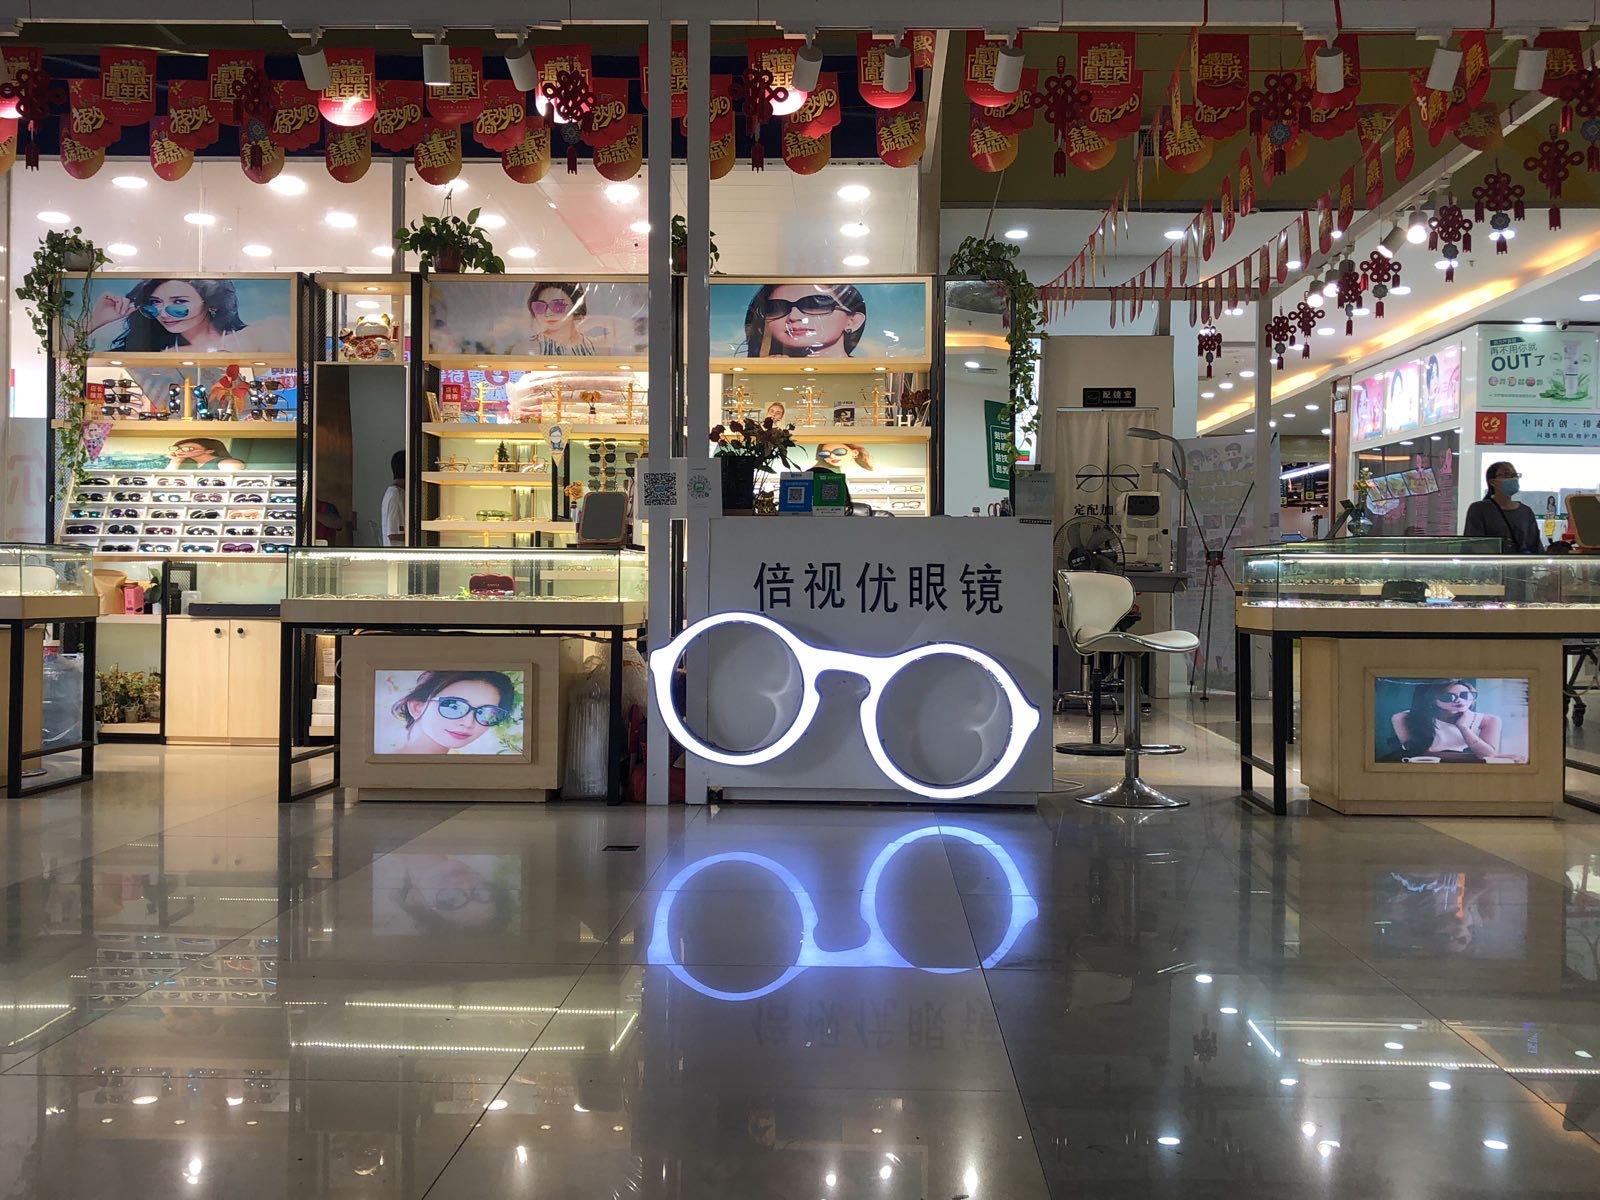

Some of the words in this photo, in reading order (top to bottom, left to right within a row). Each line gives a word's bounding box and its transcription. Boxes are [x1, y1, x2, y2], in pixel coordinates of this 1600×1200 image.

[1084, 66, 1129, 81] 周年庆
[1198, 65, 1243, 80] 周年庆
[106, 83, 149, 98] 周年庆
[325, 83, 368, 99] 周年庆
[432, 83, 477, 97] 周年庆
[753, 561, 1004, 616] 倍视优眼镜
